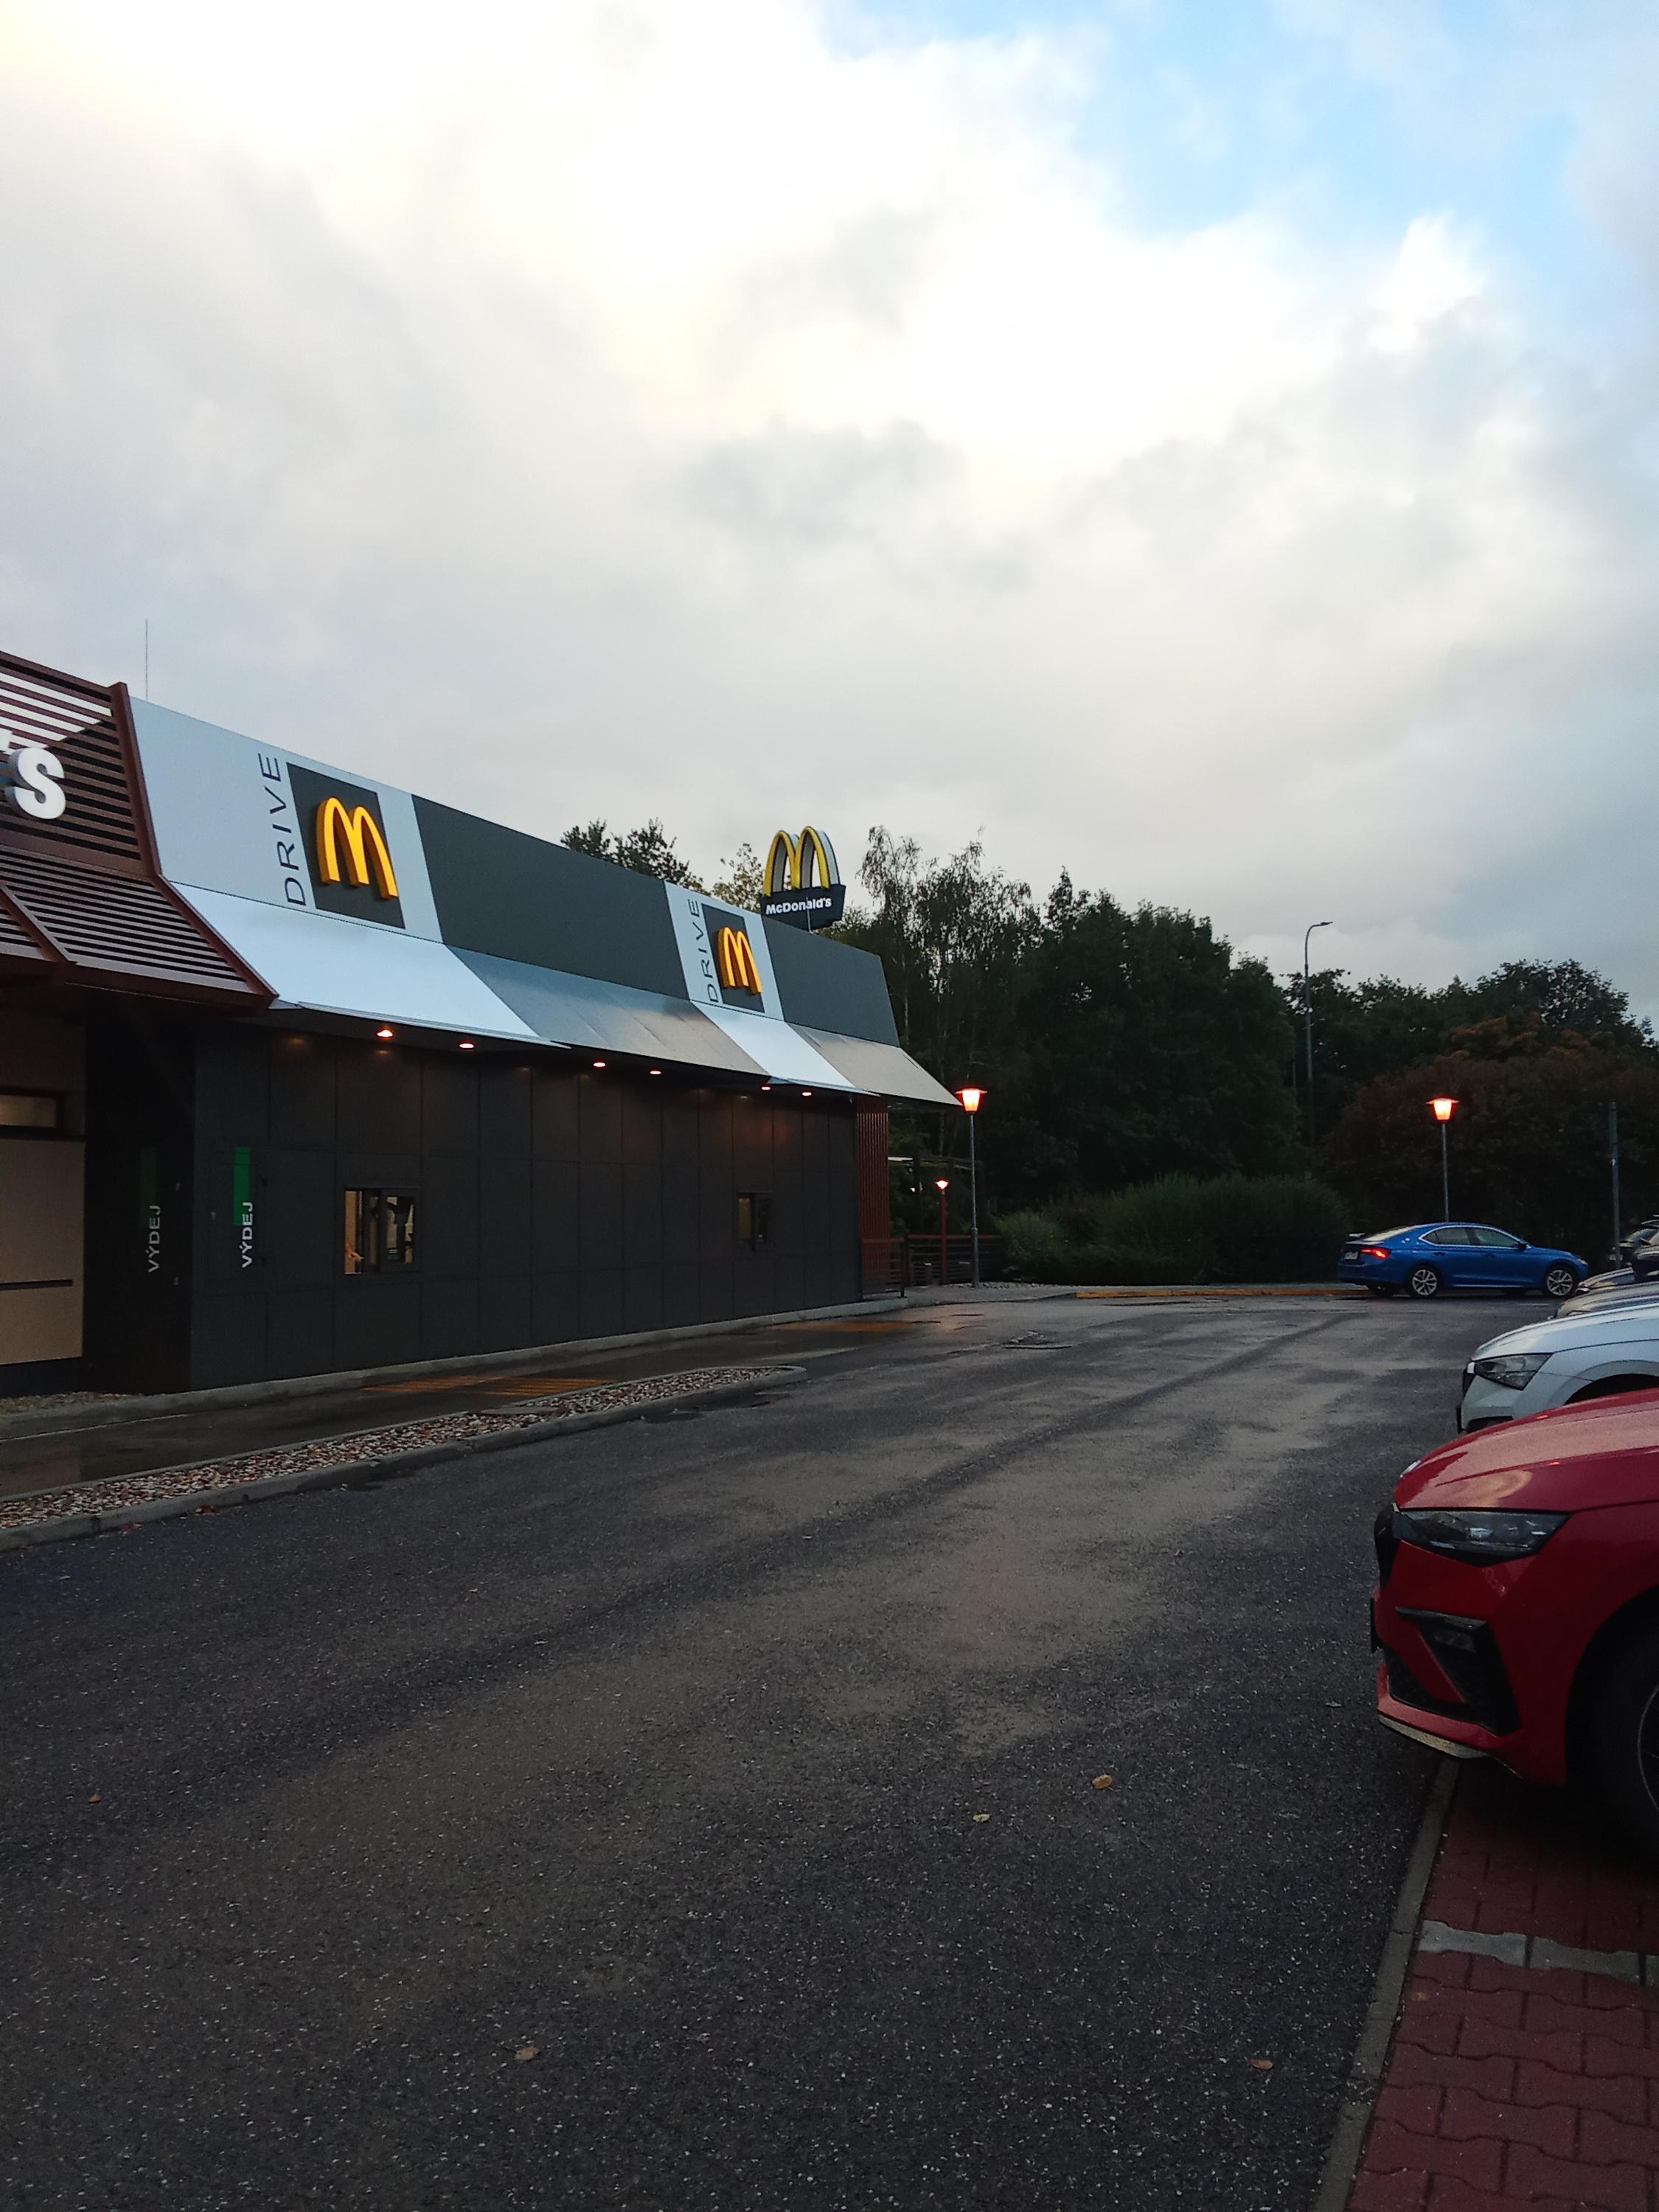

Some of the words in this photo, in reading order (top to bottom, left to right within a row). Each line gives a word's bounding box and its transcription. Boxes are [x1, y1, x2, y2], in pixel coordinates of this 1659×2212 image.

[257, 753, 307, 906] DRIVE
[765, 897, 832, 916] McDonald's
[688, 899, 720, 1003] DRIVE
[239, 1202, 254, 1269] VÝDEJ
